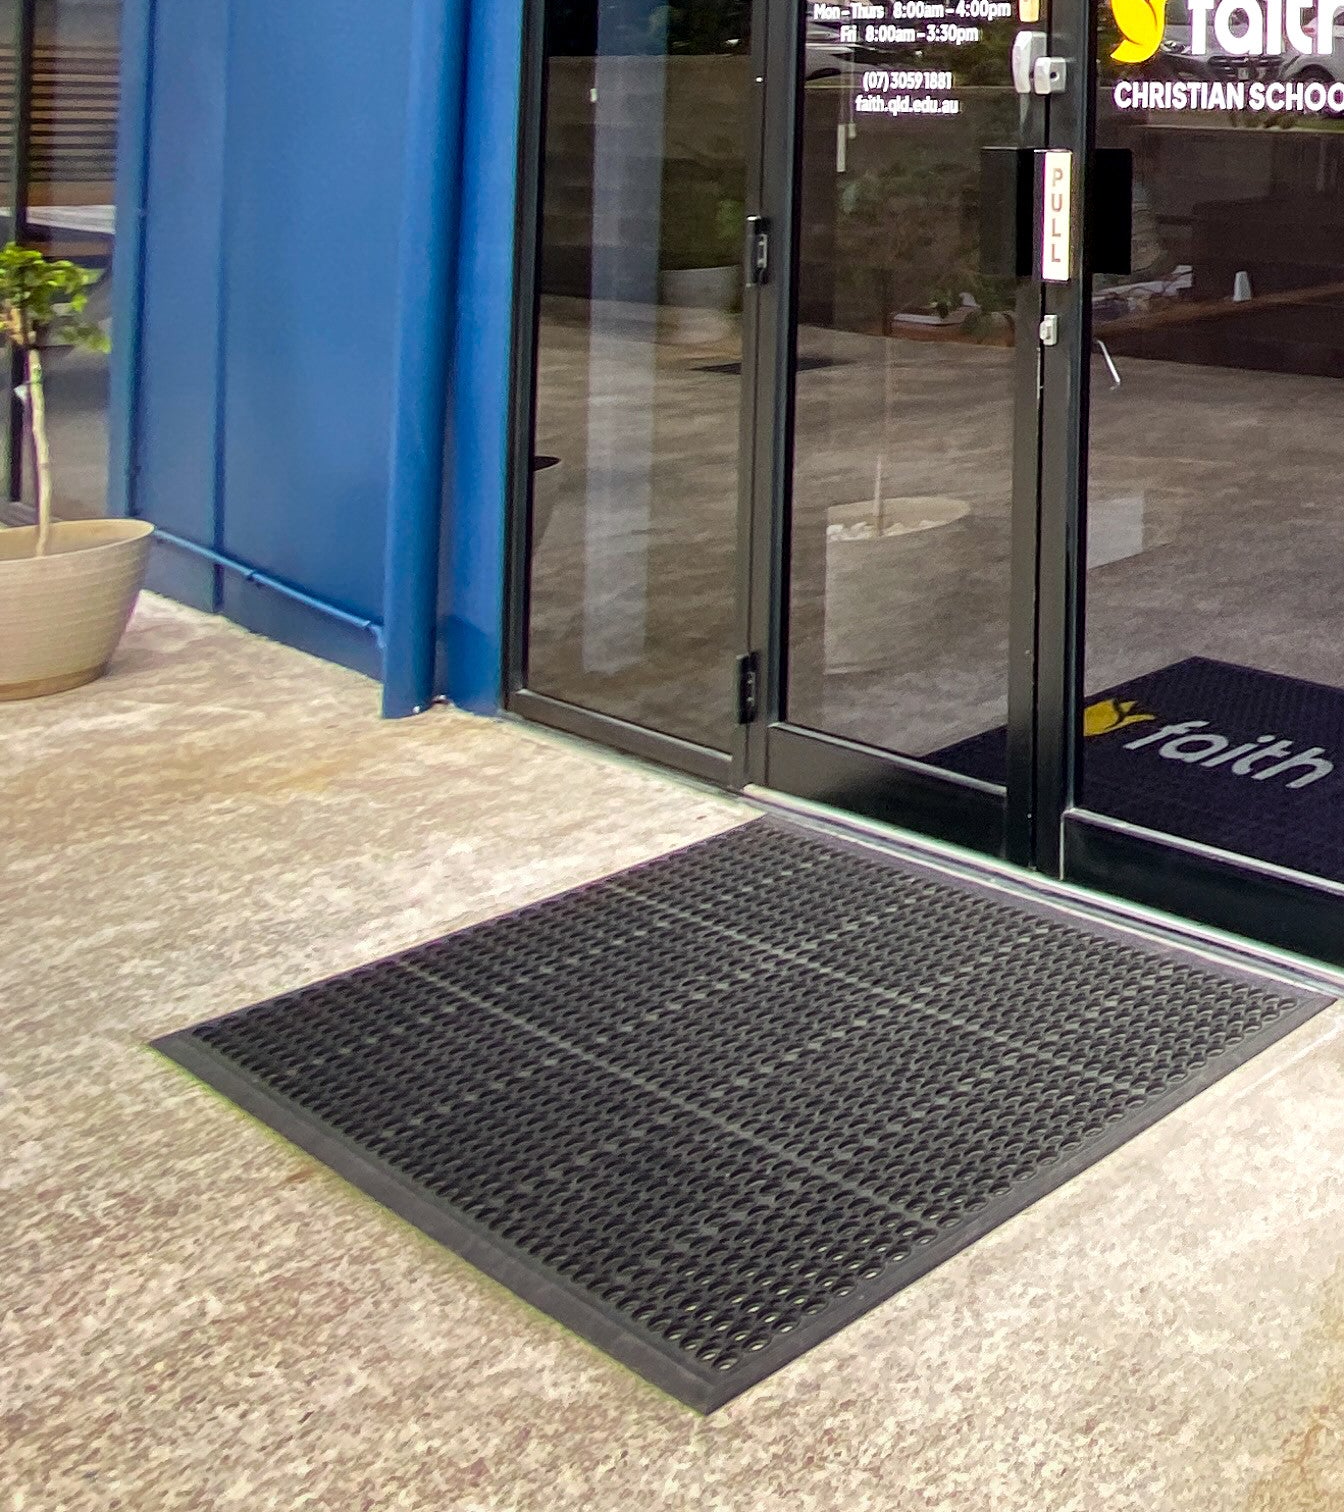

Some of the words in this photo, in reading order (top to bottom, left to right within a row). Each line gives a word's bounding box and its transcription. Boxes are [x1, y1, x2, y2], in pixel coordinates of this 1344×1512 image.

[813, 2, 840, 20] Mon
[850, 2, 885, 20] Thurs
[893, 0, 945, 19] 8:00am
[955, 0, 1012, 22] 4:00pm
[840, 24, 858, 43] Fri
[864, 24, 916, 43] 8:00am
[926, 23, 979, 46] 3:30pm
[862, 71, 889, 92] (07)
[890, 71, 924, 90] 3059
[854, 94, 960, 117] faith.qld.edu.au
[1113, 80, 1244, 110] CHRISTIAN
[1050, 168, 1064, 263] PULL
[1122, 720, 1334, 789] faith
